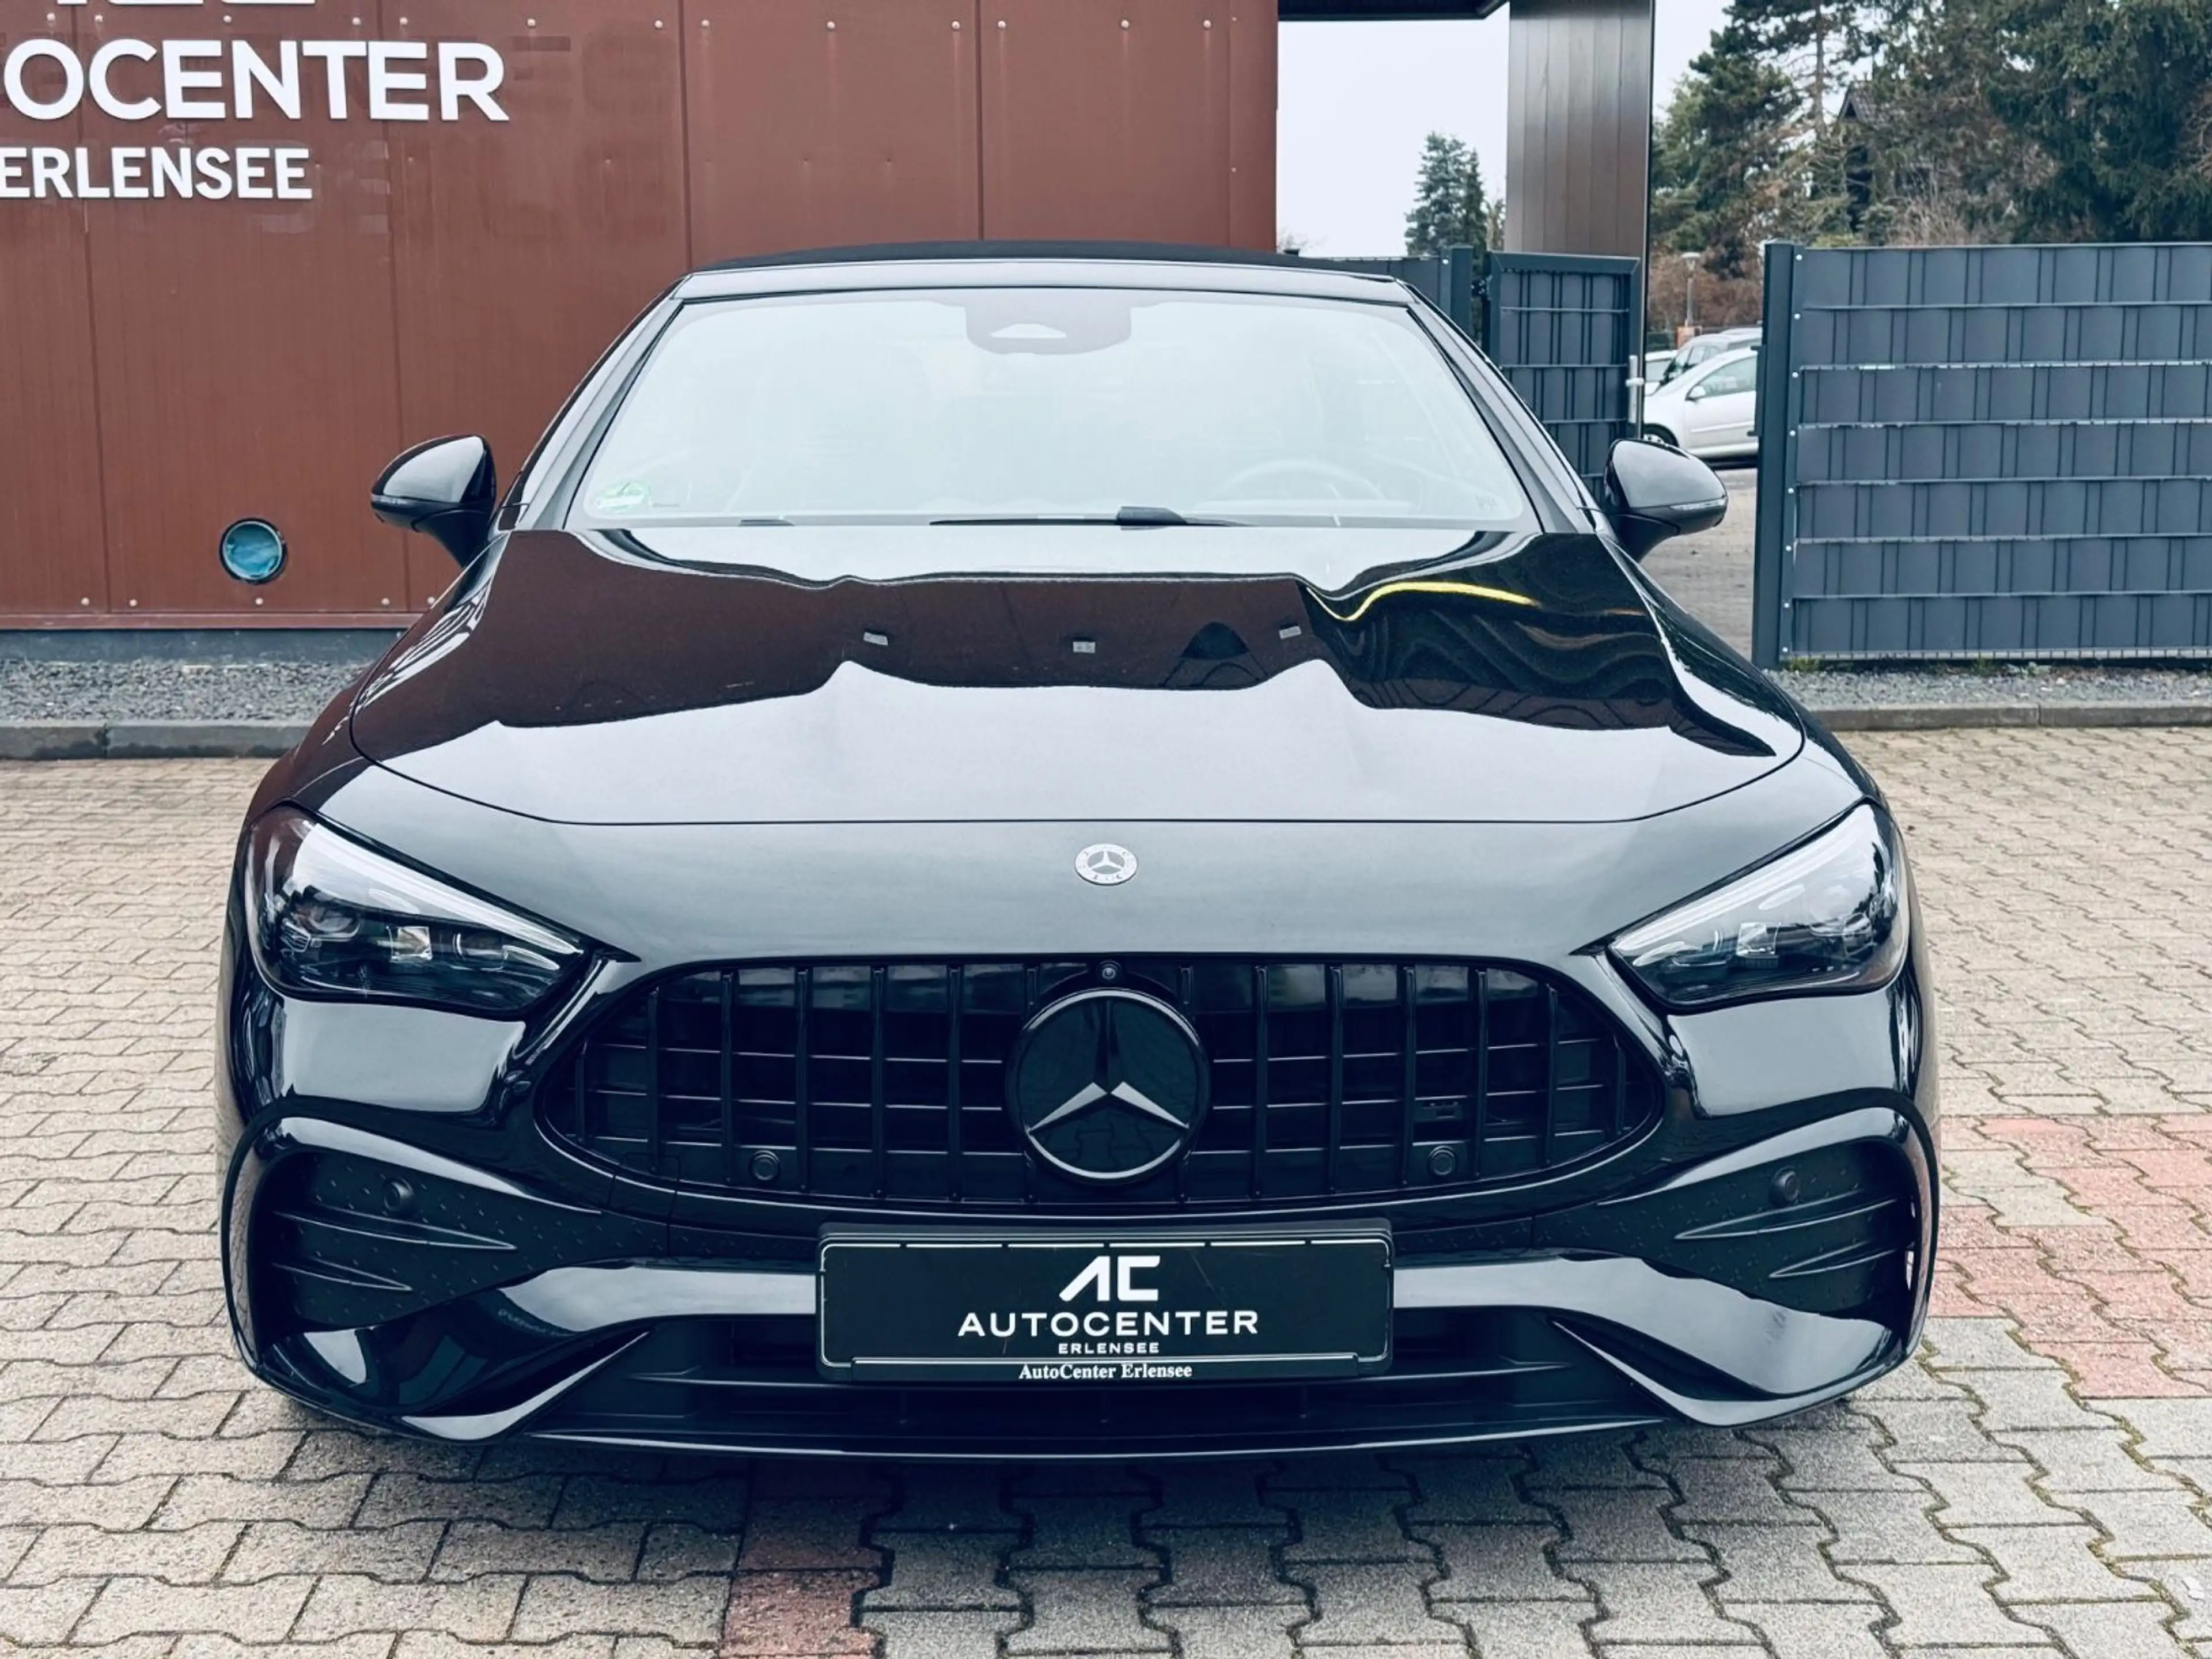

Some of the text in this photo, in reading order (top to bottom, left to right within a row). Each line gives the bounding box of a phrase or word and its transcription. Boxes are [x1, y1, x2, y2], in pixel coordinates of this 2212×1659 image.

[4, 39, 510, 120] OCENTER
[0, 147, 312, 199] ERLENSEE
[957, 1310, 1258, 1337] AUTOCENTER
[1058, 1342, 1160, 1354] ERLENSEE
[1018, 1363, 1192, 1379] AutoCenter Erlensee
